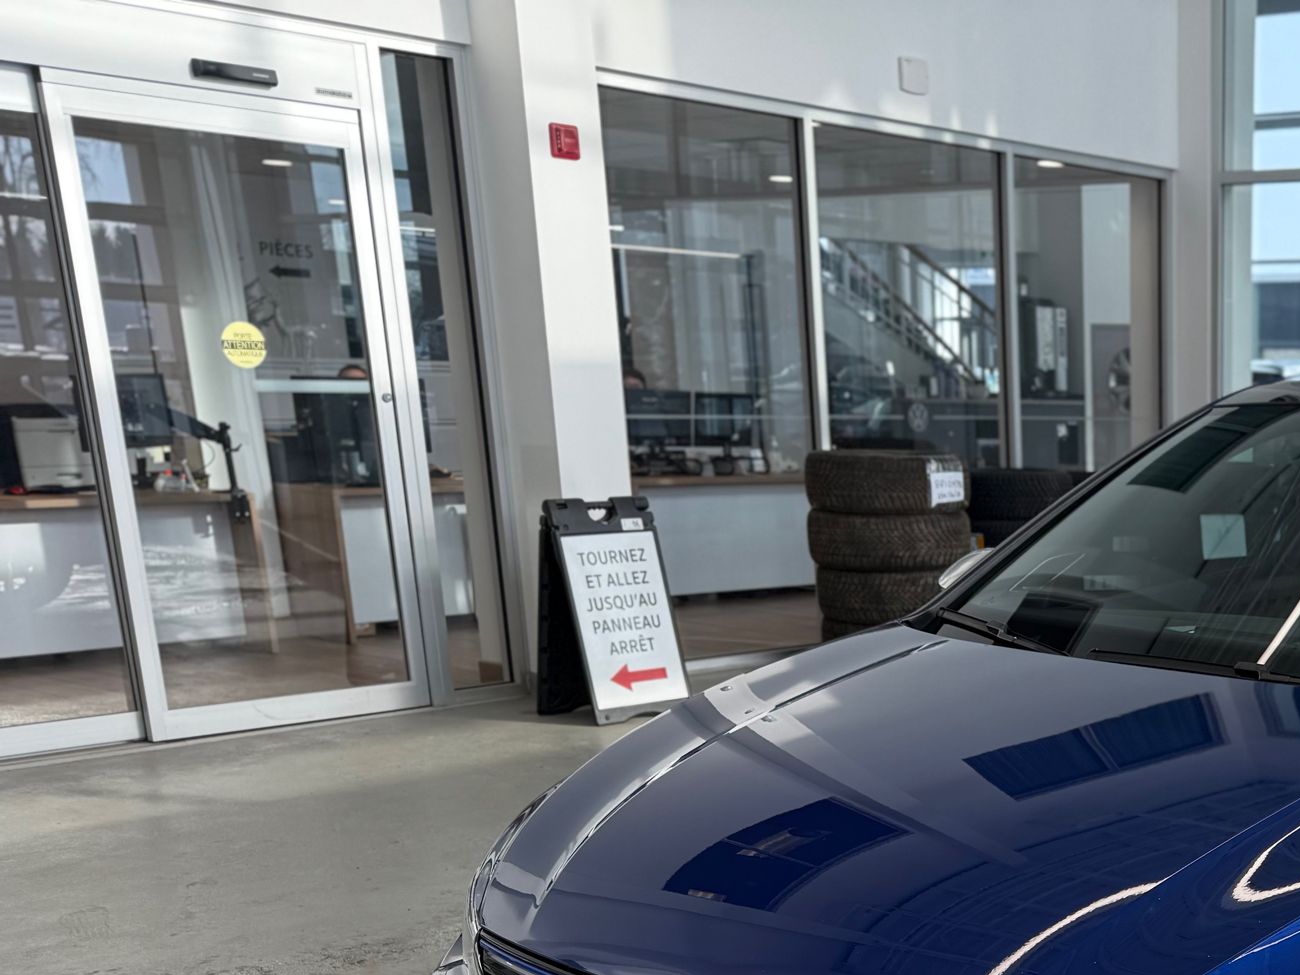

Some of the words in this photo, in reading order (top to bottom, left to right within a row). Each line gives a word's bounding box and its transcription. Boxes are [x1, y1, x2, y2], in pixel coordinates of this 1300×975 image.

[258, 238, 313, 259] PIÈCES
[223, 340, 264, 350] ATTENTION
[577, 548, 647, 567] TOURNEZ
[585, 574, 602, 589] ET
[607, 570, 649, 587] ALLEZ
[586, 592, 657, 612] JUSQU'AU
[592, 614, 661, 635] PANNEAU
[609, 634, 655, 656] ARRÊT
